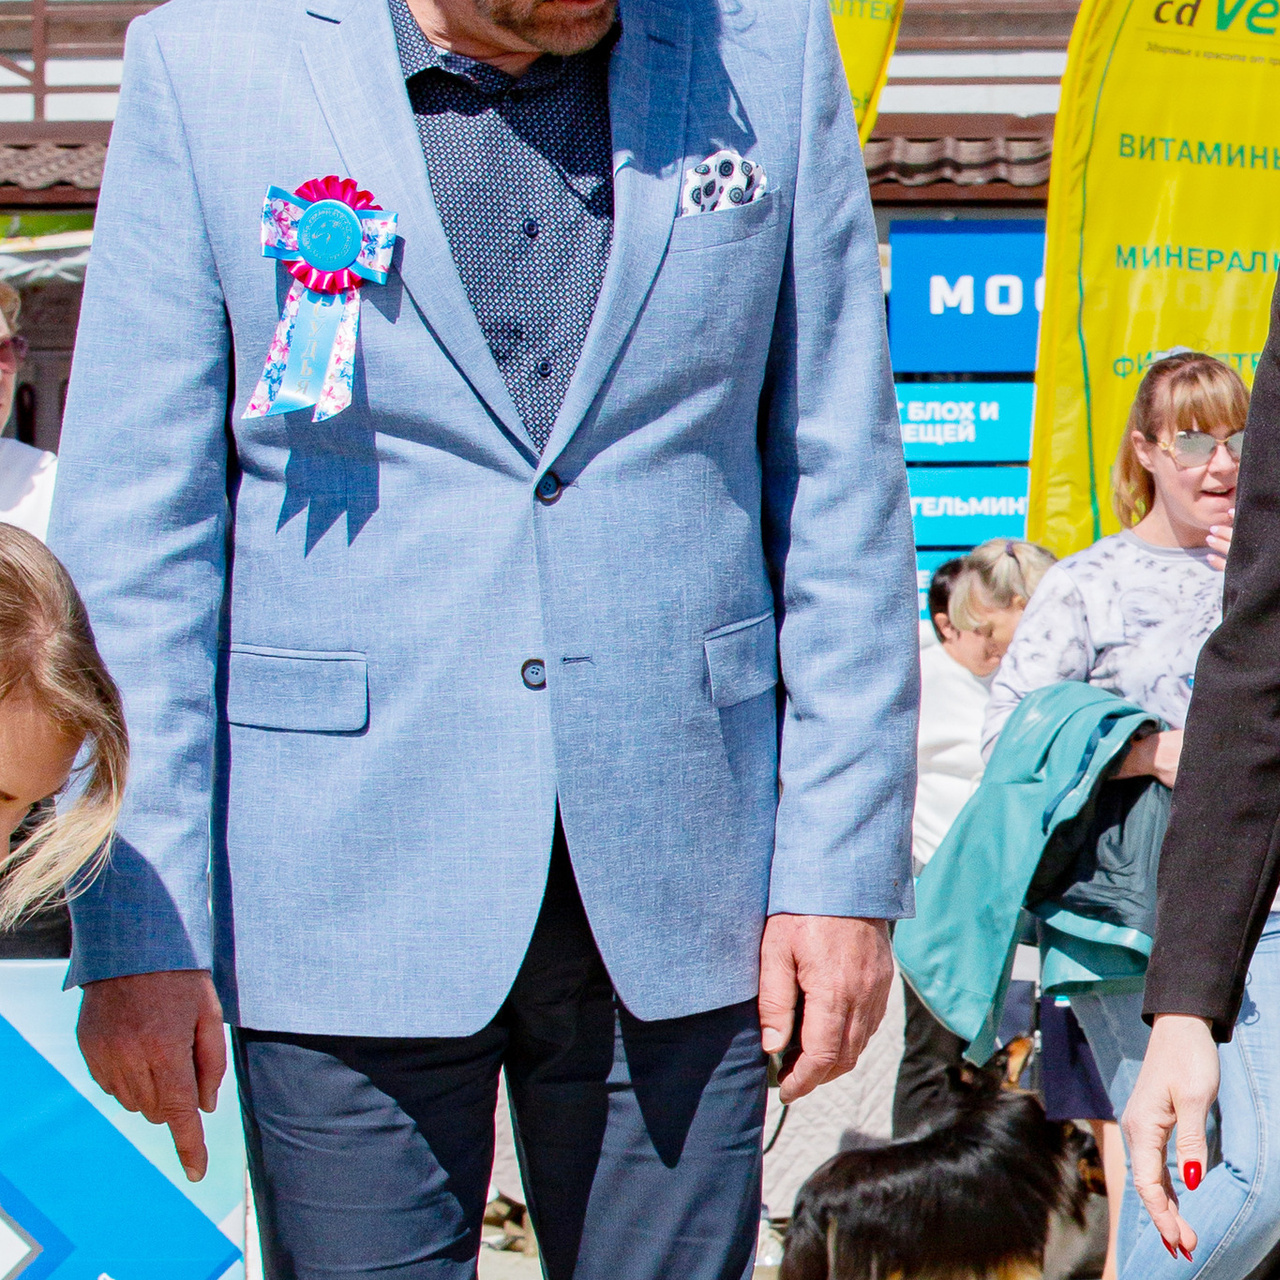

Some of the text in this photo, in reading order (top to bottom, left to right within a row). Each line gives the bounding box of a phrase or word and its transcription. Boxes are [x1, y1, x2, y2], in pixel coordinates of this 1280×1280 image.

[295, 297, 330, 395] СУДЬЯ
[907, 401, 999, 421] БЛОХ И
[902, 421, 976, 445] ЕЩЕЙ
[910, 495, 1028, 517] ГЕЛЬМИН
